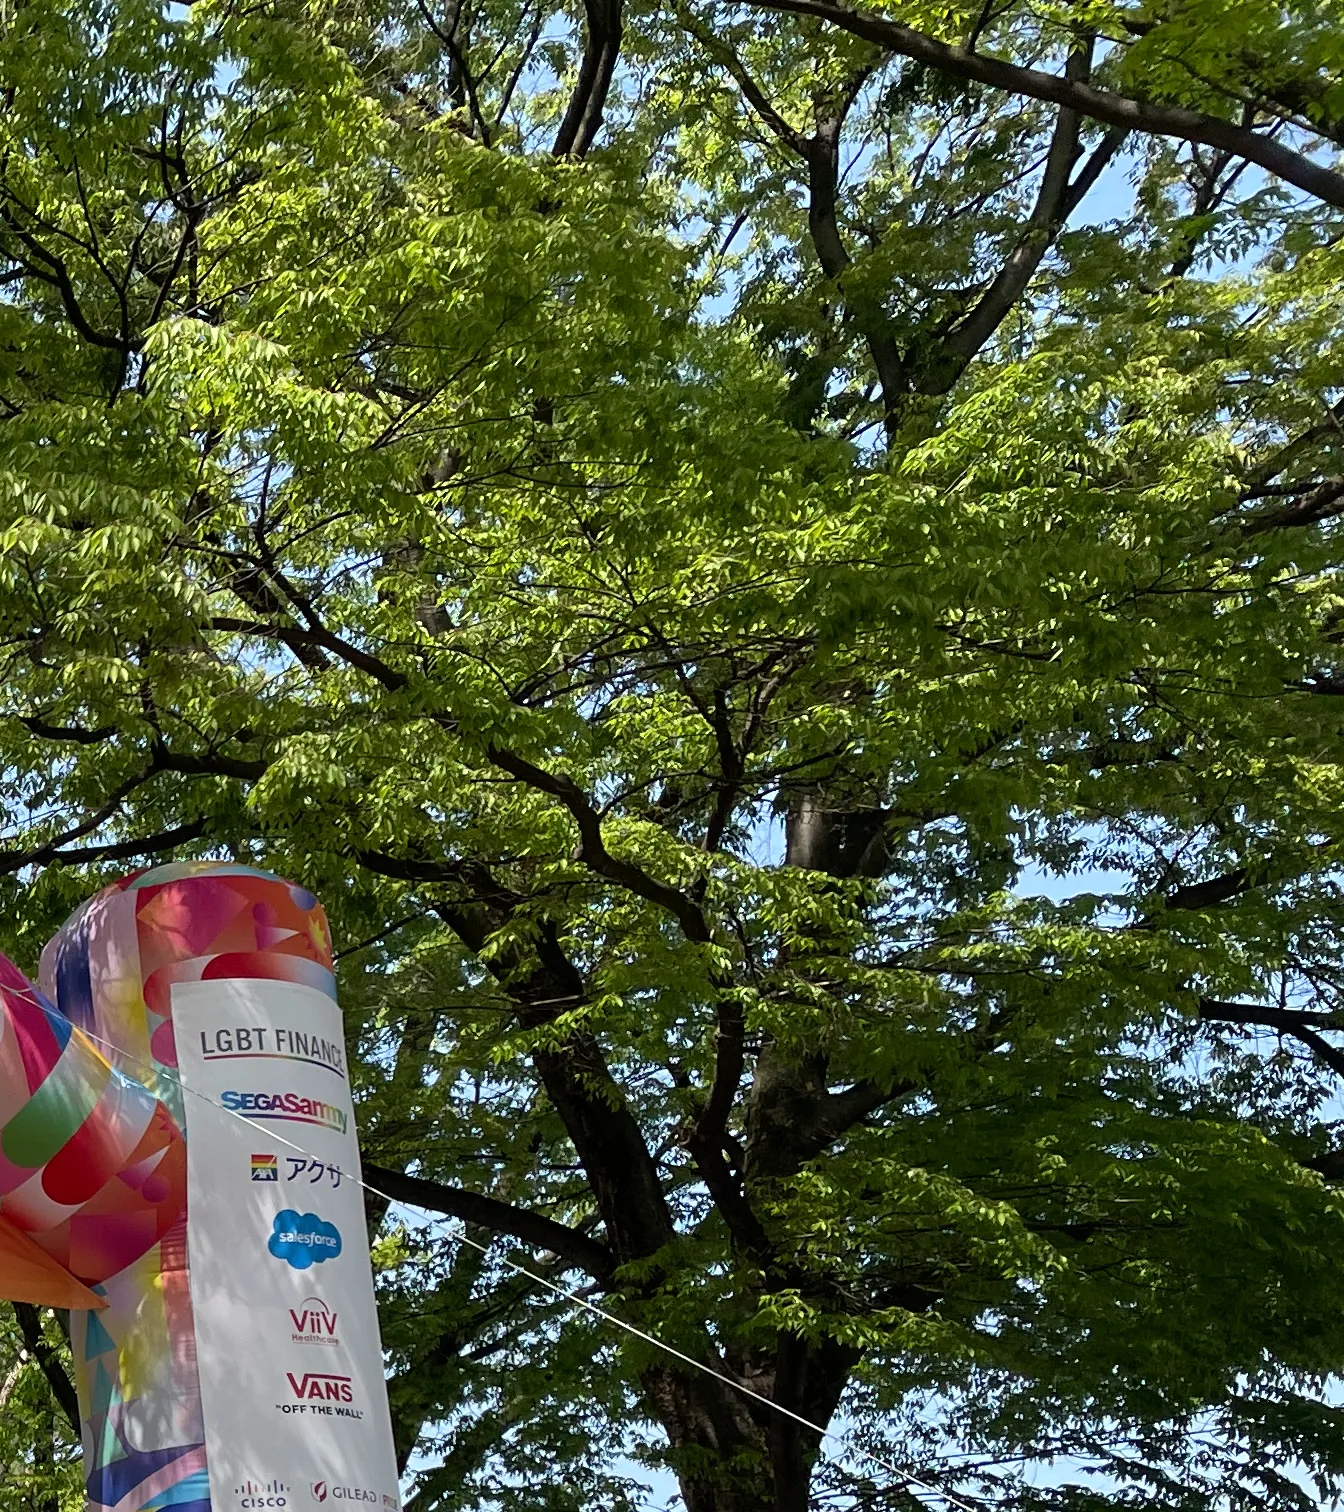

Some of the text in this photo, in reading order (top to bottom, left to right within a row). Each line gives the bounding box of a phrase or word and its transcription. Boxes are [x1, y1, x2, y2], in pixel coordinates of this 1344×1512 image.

[200, 1028, 345, 1073] LGBT FINANCE
[286, 1157, 343, 1188] アクサ
[279, 1230, 337, 1248] salesforce
[289, 1309, 338, 1335] ViiV
[291, 1333, 339, 1345] Healthcare
[286, 1372, 353, 1403] VANS
[310, 1405, 333, 1416] THE
